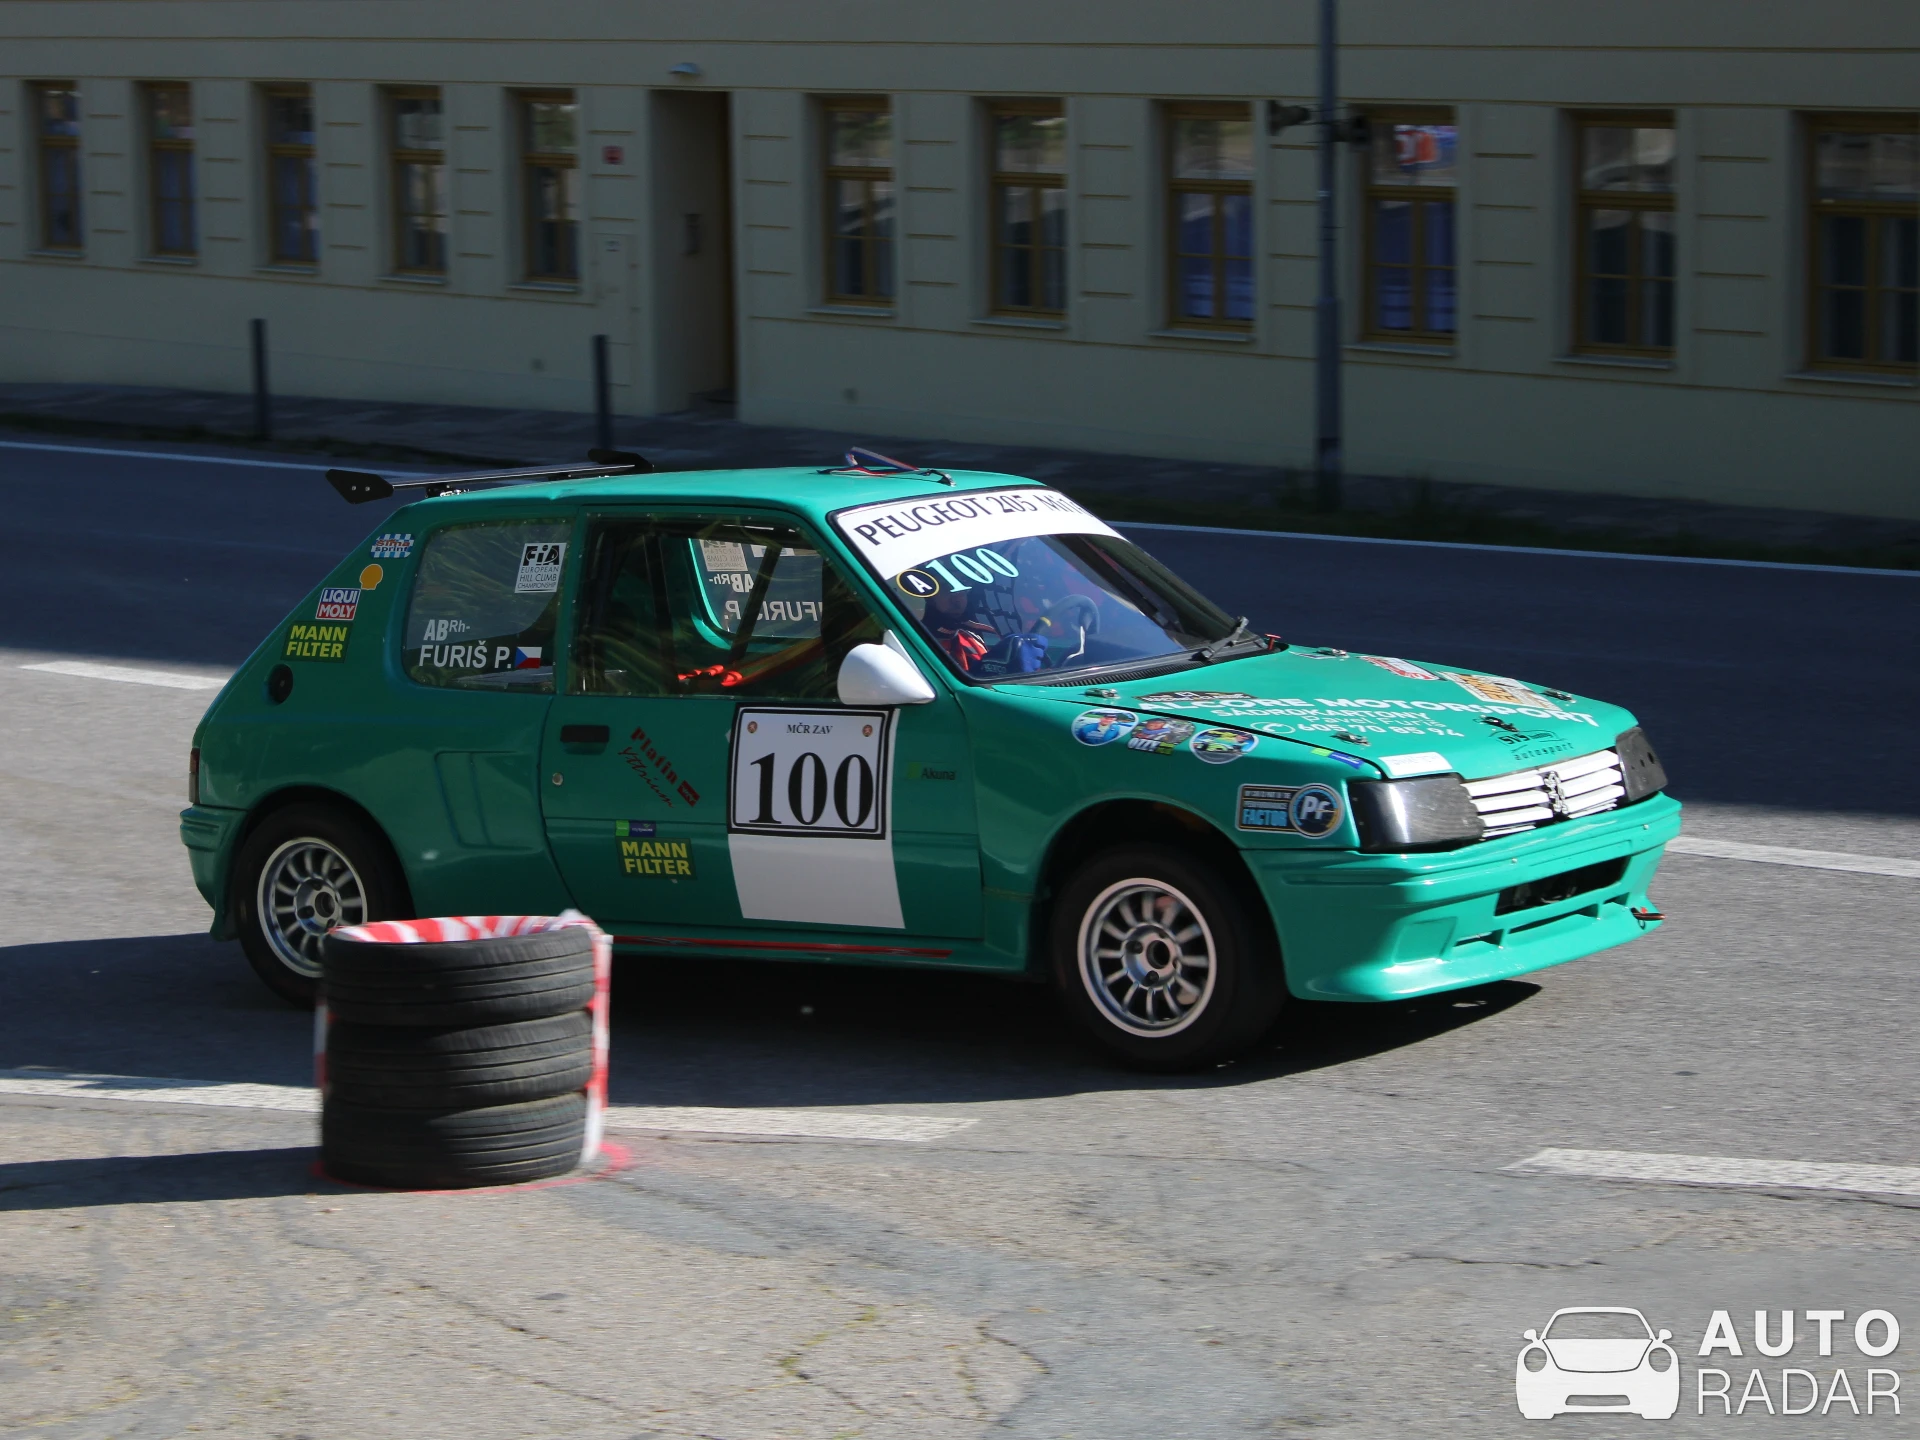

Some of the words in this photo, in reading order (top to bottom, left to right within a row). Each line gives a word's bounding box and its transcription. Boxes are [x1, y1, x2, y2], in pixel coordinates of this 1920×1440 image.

[853, 497, 992, 546] PEUGEOT
[986, 494, 1037, 512] 205
[519, 574, 533, 582] HILL
[535, 573, 557, 582] CLIMB
[520, 566, 559, 574] EUROPEAN
[906, 574, 933, 594] A
[925, 548, 1019, 593] 100
[322, 589, 358, 603] LIQUI
[318, 604, 356, 618] MOLY
[290, 625, 347, 642] MANN
[286, 641, 344, 658] FILTER
[419, 640, 487, 668] FURIŠ
[494, 646, 512, 669] P.
[1139, 699, 1314, 711] ALCORE
[1314, 699, 1600, 727] MOTORSPORT
[786, 722, 810, 734] MČR
[813, 725, 833, 735] ZAV
[1348, 724, 1387, 733] 70
[630, 726, 678, 785] Platin
[920, 767, 956, 780] Akuna
[748, 752, 874, 828] 100
[621, 841, 688, 858] MANN
[624, 858, 691, 875] FILTER
